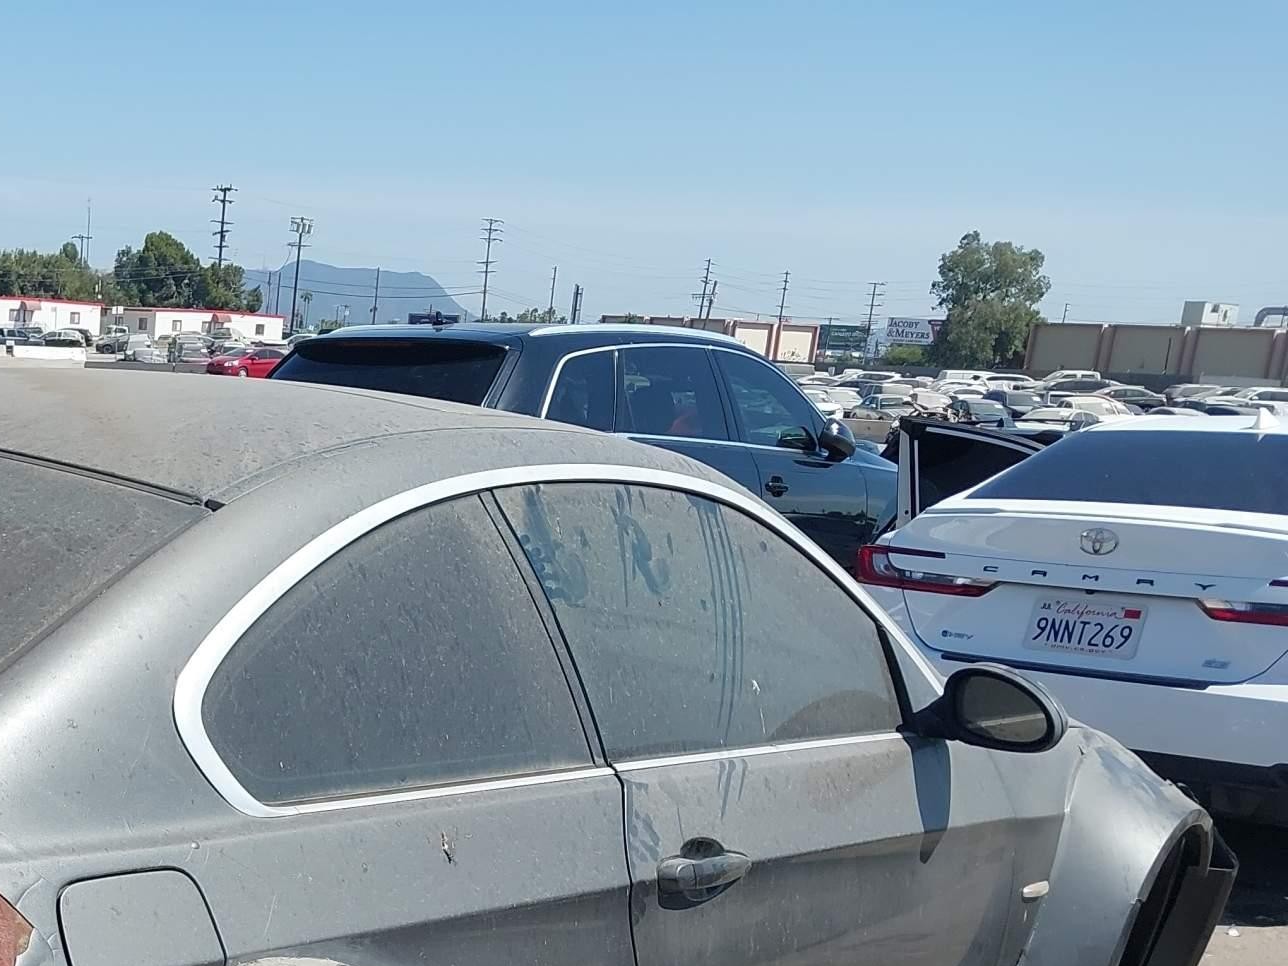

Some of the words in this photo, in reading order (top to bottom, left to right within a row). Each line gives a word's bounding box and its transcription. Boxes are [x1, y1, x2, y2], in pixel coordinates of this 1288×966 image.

[888, 317, 920, 328] JACOBY
[983, 565, 1217, 590] CAMRY
[1056, 600, 1123, 620] California
[1032, 616, 1133, 650] 9NNT269
